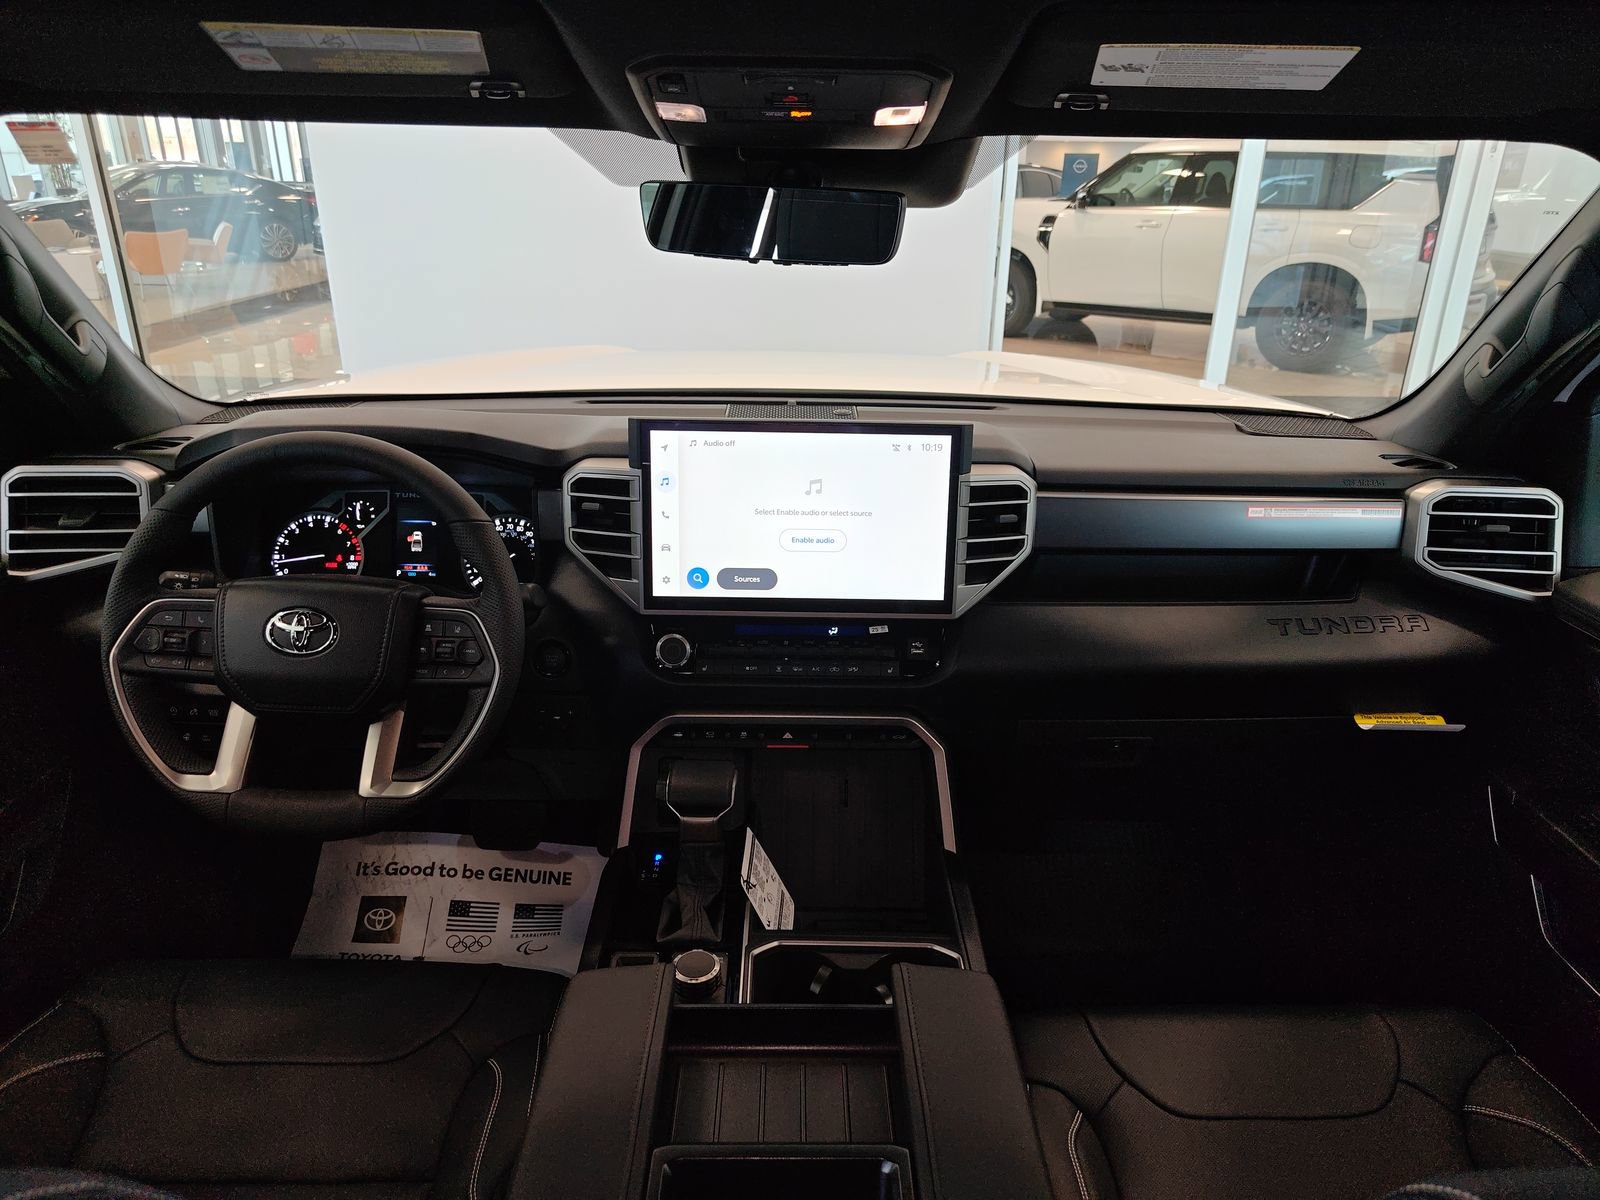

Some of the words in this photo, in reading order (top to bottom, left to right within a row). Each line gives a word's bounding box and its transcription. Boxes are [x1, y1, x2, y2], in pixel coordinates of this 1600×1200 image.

[703, 438, 724, 448] Audio
[724, 438, 735, 448] off
[920, 443, 943, 452] 10:19
[754, 507, 775, 517] Select
[776, 508, 799, 517] Enable
[800, 508, 820, 517] audio
[828, 508, 849, 518] select
[850, 510, 873, 518] source
[791, 536, 815, 545] Enable
[816, 536, 835, 545] audio
[396, 569, 402, 577] P
[733, 574, 761, 584] Sources
[1266, 614, 1430, 636] TUNDRA
[1399, 713, 1425, 721] Equipped
[355, 861, 381, 877] It's
[384, 861, 436, 877] Good
[438, 863, 458, 878] to
[462, 862, 485, 880] be
[488, 866, 573, 886] GENUINE
[522, 931, 561, 939] PARALYMPICS
